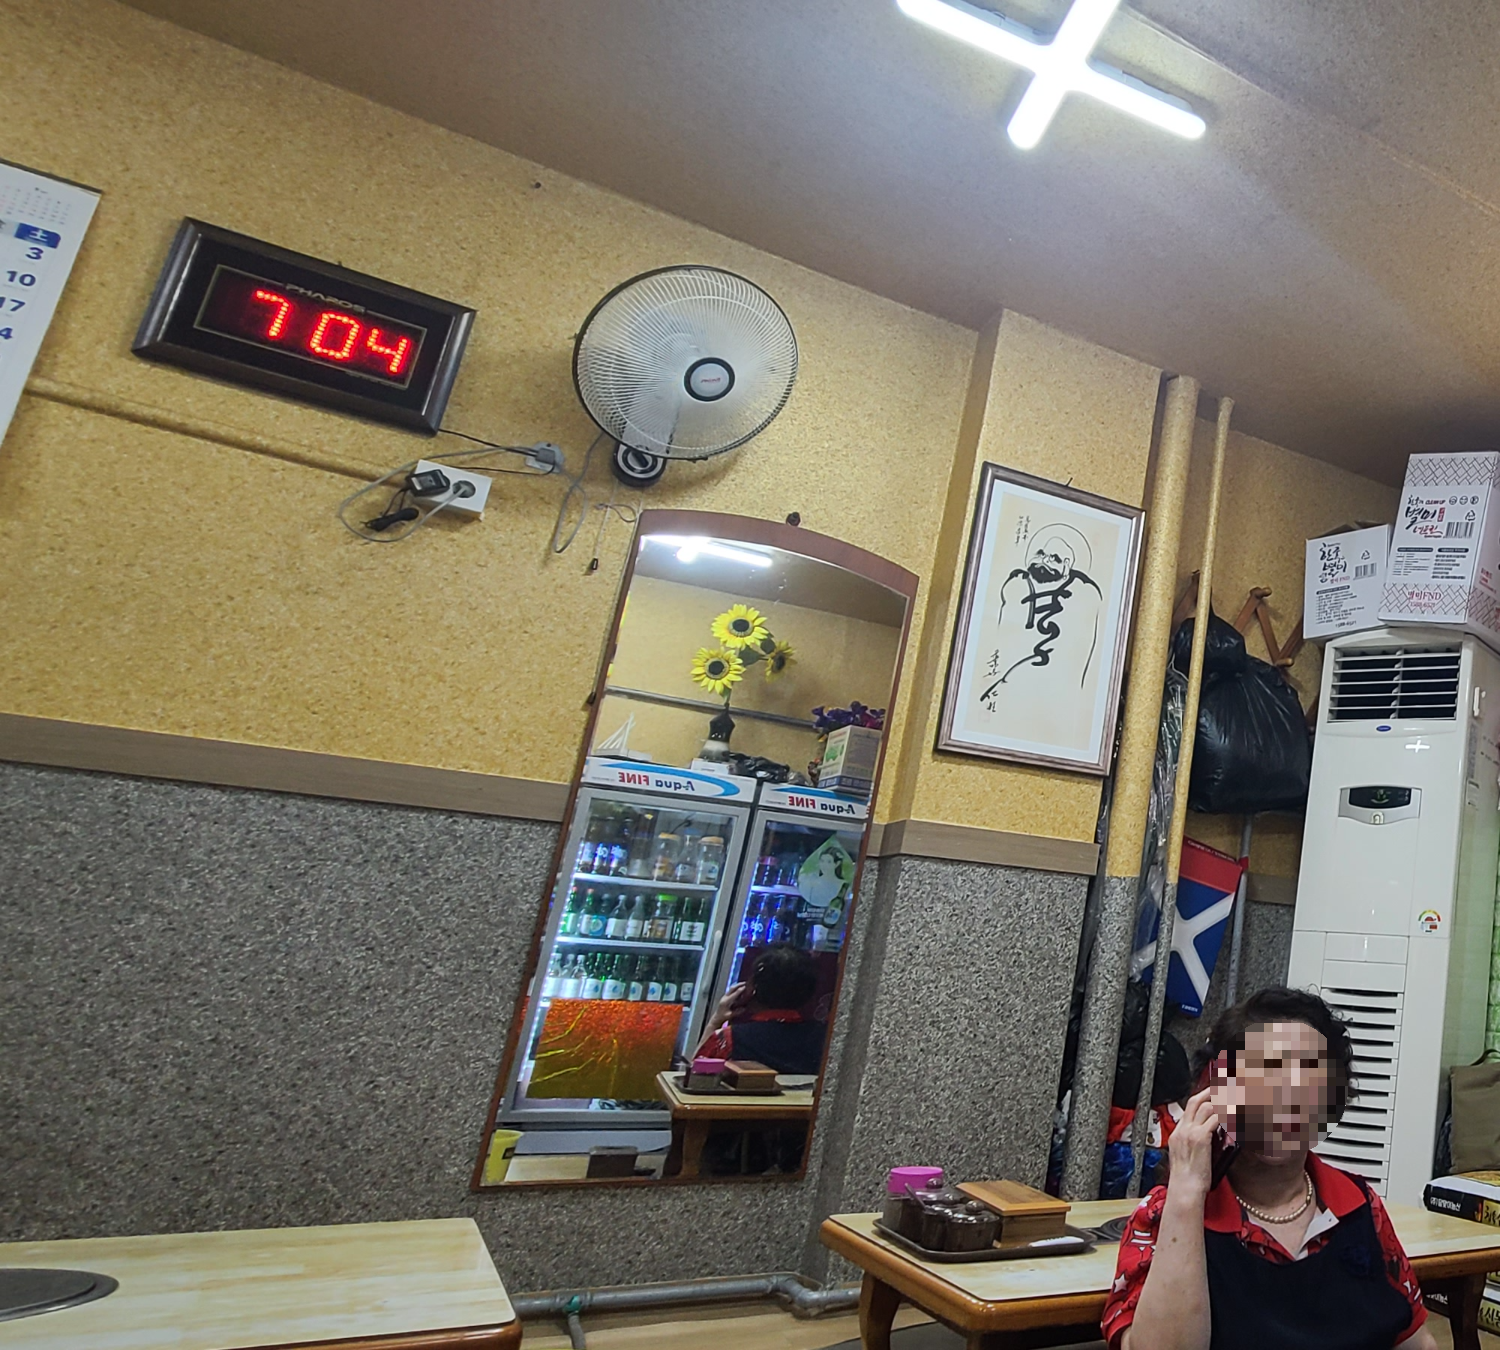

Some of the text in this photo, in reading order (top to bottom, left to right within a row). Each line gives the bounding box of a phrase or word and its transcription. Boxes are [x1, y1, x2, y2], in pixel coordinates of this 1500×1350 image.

[25, 247, 44, 260] 3
[6, 270, 36, 287] 10
[285, 283, 366, 314] PHAROS
